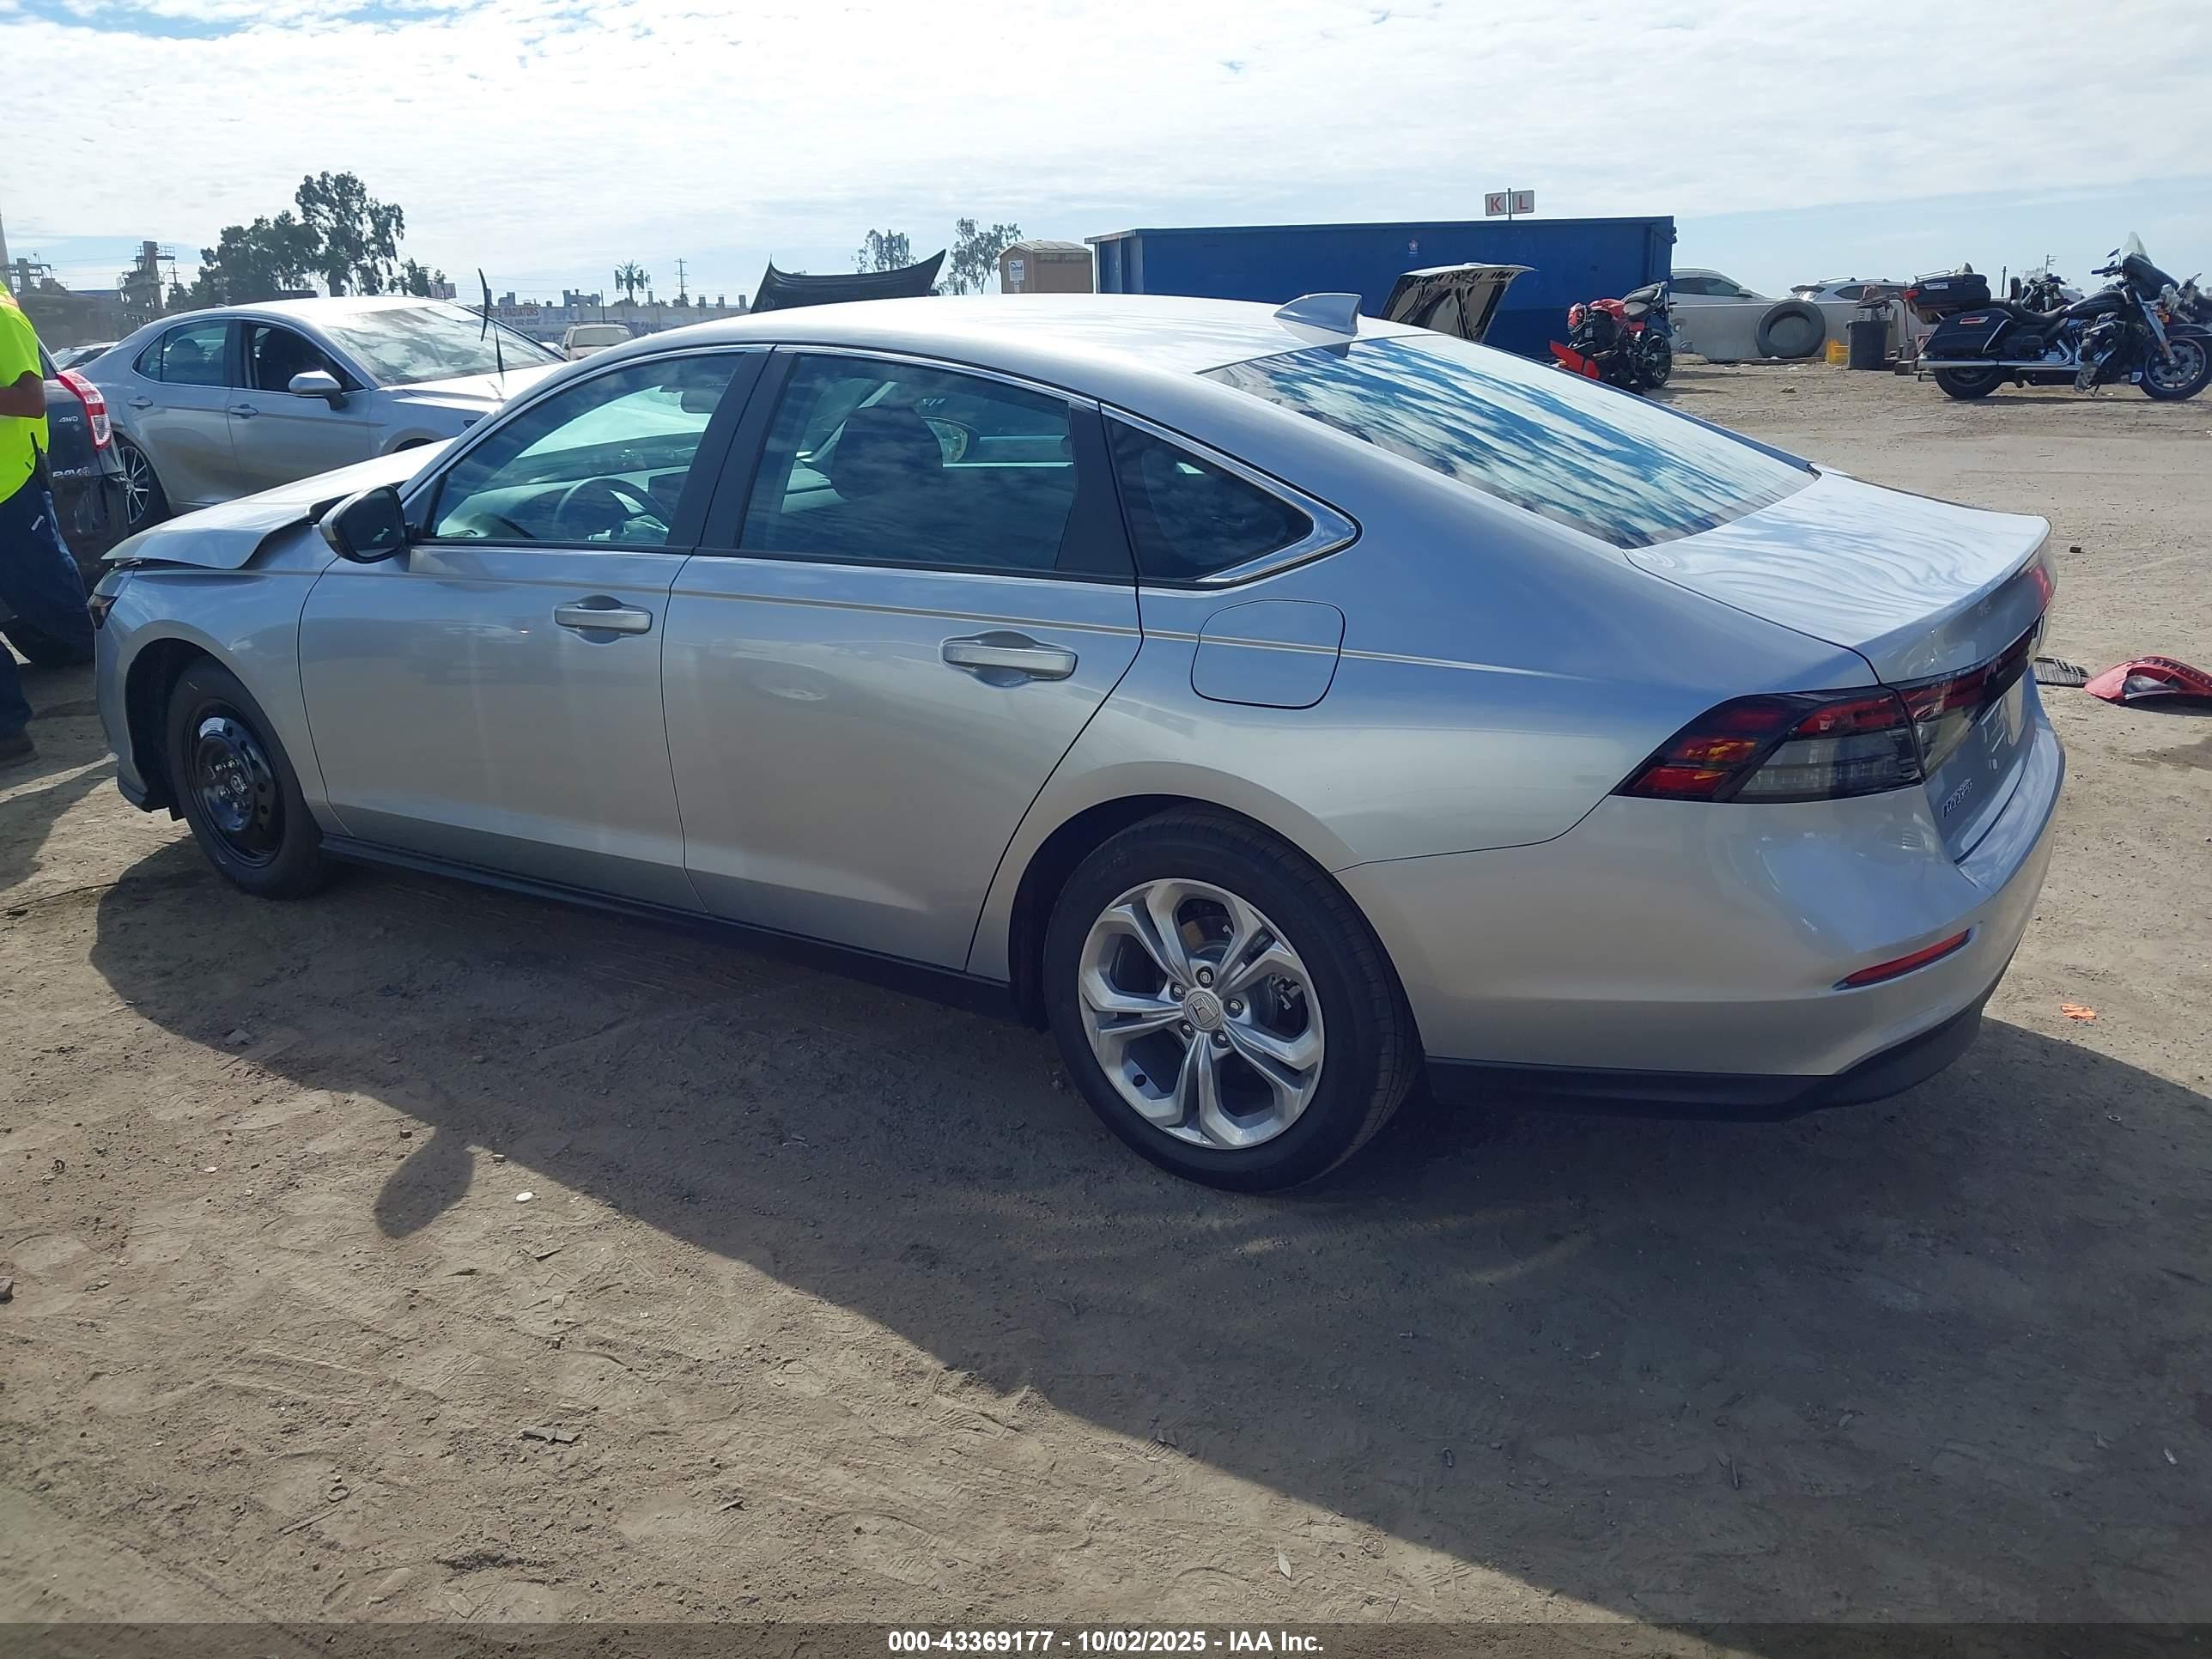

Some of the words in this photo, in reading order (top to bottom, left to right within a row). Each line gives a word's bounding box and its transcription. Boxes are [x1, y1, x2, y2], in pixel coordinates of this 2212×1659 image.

[1490, 196, 1502, 212] K
[1519, 194, 1528, 210] L
[52, 466, 89, 477] RAV4
